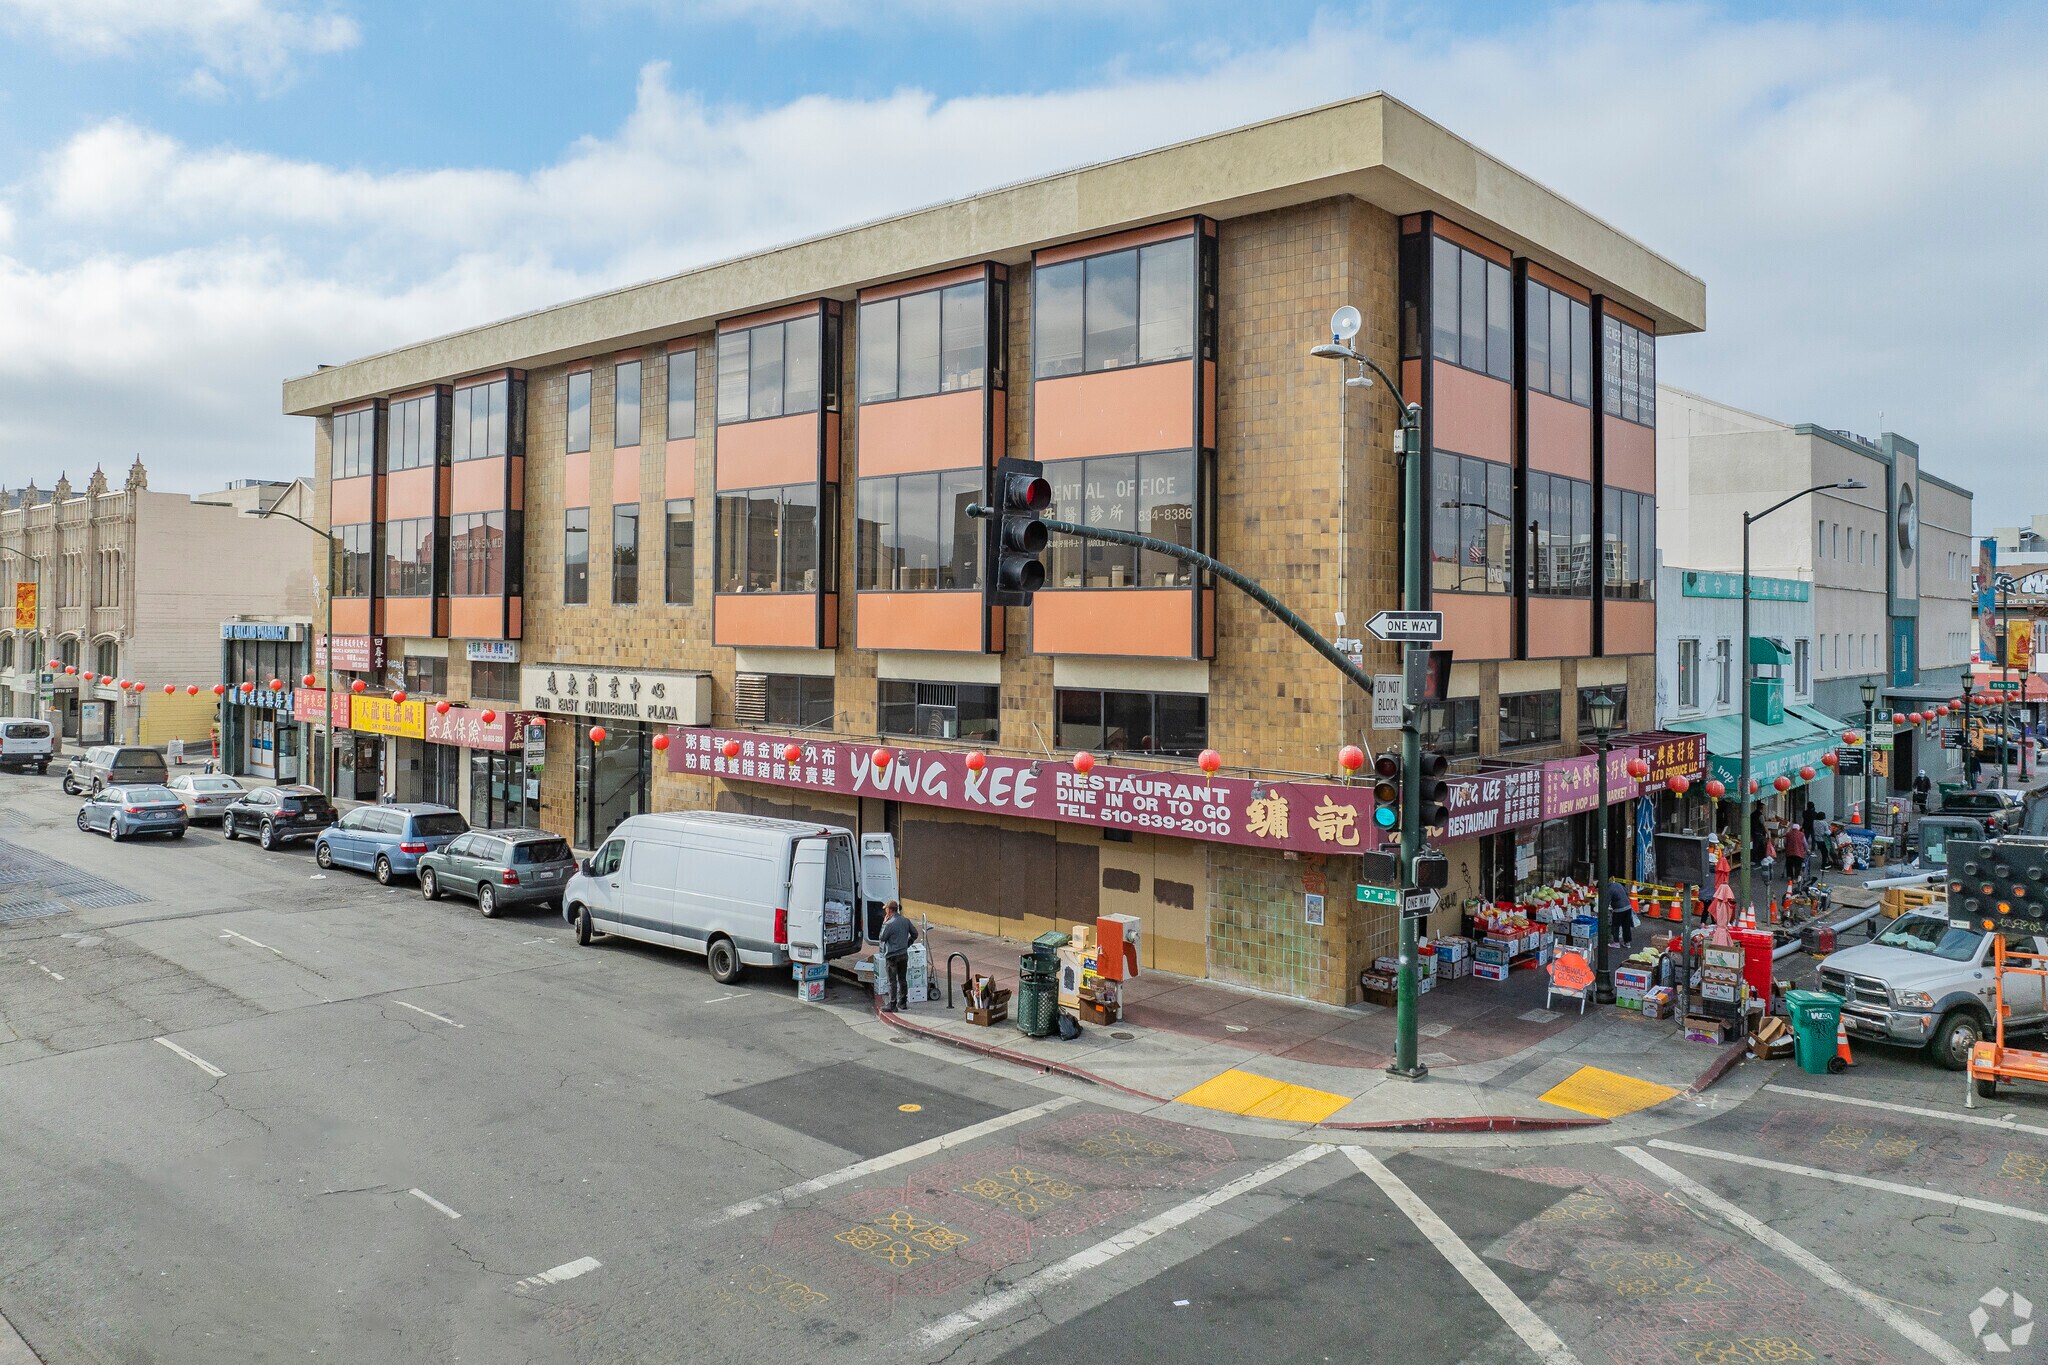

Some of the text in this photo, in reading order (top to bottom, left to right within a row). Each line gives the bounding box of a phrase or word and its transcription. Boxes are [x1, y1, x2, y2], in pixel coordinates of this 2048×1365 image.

[1116, 477, 1176, 498] OFFICE
[1138, 507, 1193, 522] 834-8386
[1387, 620, 1433, 631] ONE WAY
[1377, 681, 1400, 694] DO NOT
[535, 696, 678, 721] FAR EAST COMMERCIAL PLAZA
[1378, 698, 1398, 711] BLOCK
[850, 751, 1039, 809] YUNG KEE
[1717, 765, 1735, 784] hop
[1056, 771, 1231, 804] RESTAURANT
[1483, 780, 1501, 803] KEE
[1056, 787, 1231, 821] DINE IN OR TO GO
[1559, 799, 1575, 815] NEW
[1575, 796, 1588, 811] HOP
[1056, 803, 1231, 836] TEL. 510-839-2010
[1448, 809, 1499, 837] RESTAURANT
[1407, 897, 1418, 909] ONE
[1420, 895, 1431, 907] WAY
[1555, 963, 1588, 977] SIDEWALK
[1557, 971, 1584, 985] CLOSED
